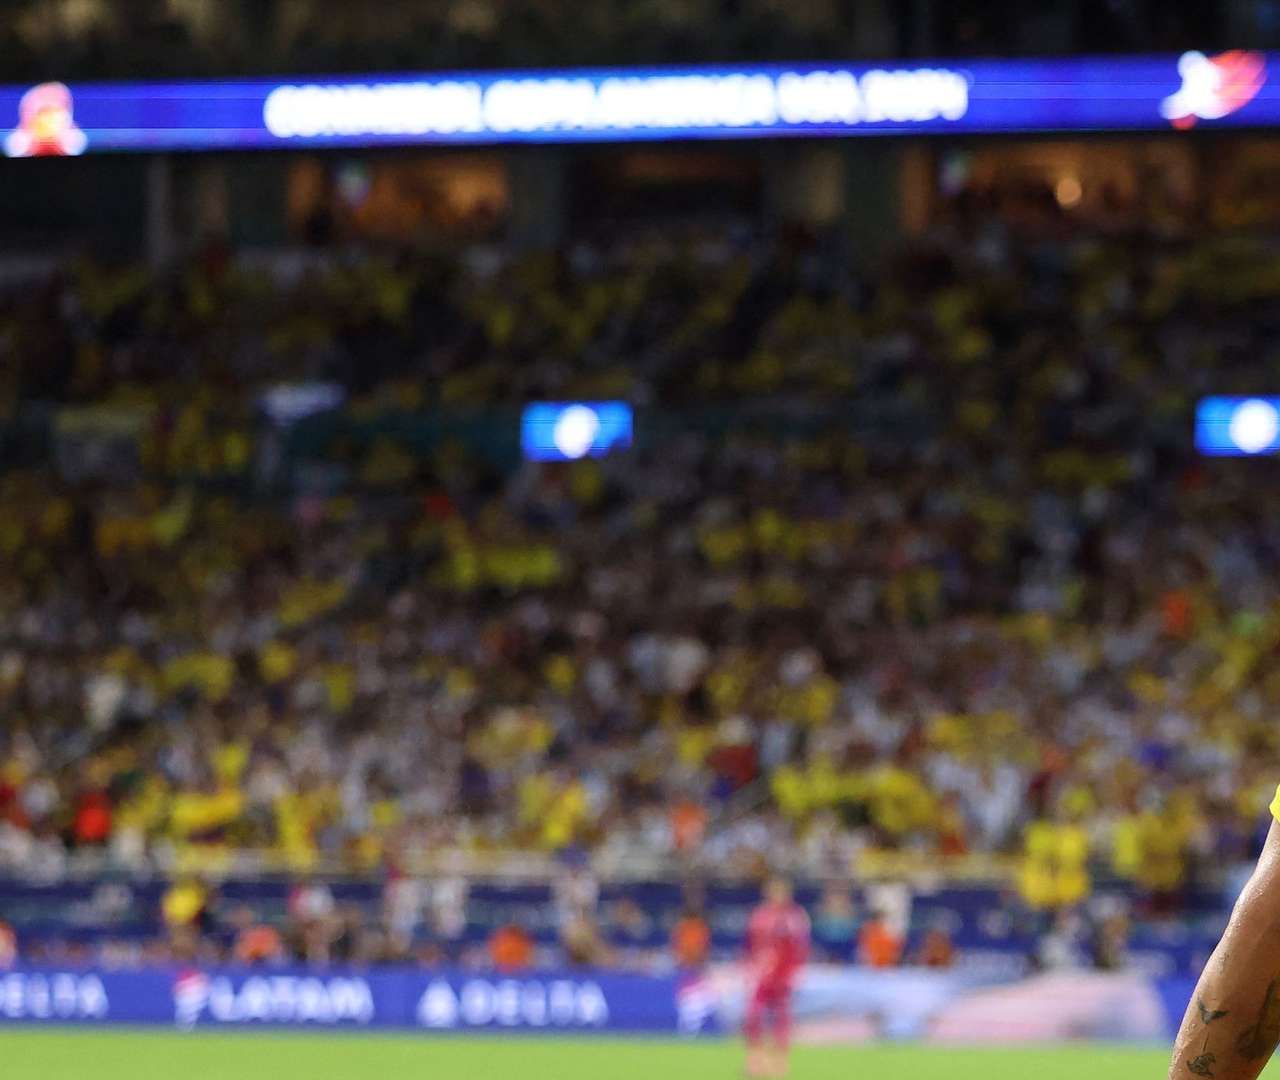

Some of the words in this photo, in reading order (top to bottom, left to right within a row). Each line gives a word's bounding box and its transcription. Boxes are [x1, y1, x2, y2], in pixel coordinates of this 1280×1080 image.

[0, 973, 110, 1019] ELTA
[209, 976, 375, 1024] LATAM
[460, 979, 610, 1027] DELTA
